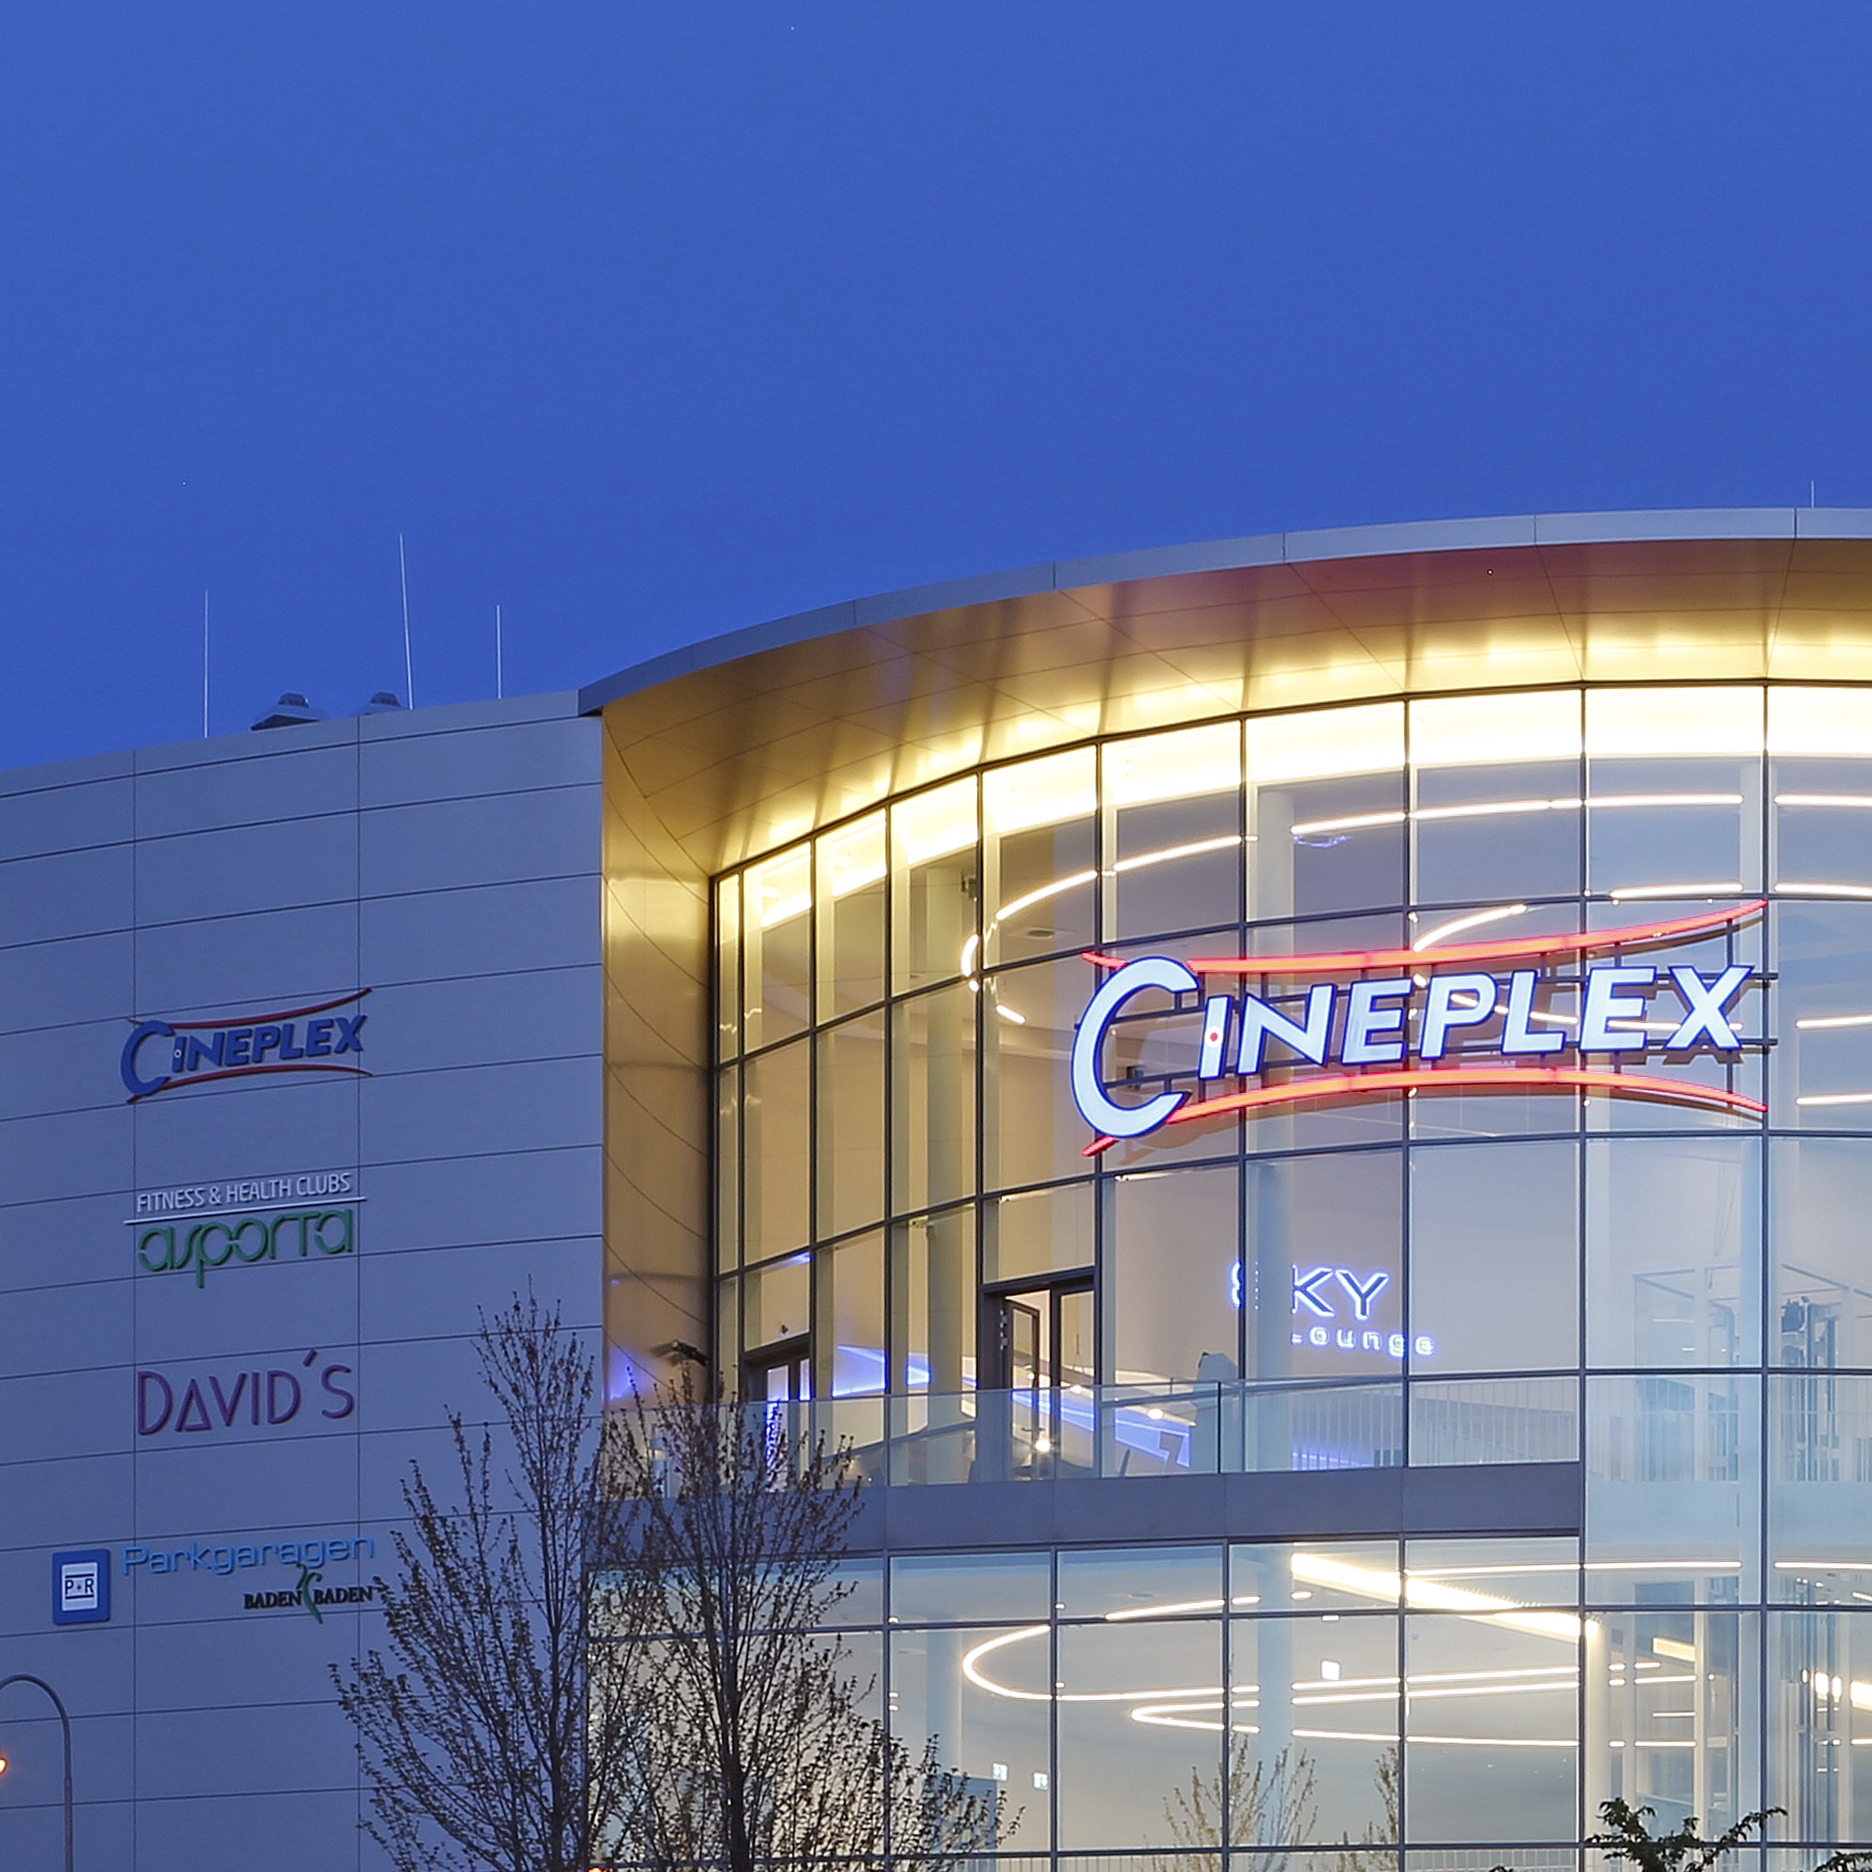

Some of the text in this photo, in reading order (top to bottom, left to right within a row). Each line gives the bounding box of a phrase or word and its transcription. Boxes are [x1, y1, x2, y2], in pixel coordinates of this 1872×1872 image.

[120, 1014, 368, 1097] CINEPLEX
[1070, 955, 1755, 1138] CINEPLEX
[136, 1172, 351, 1213] FITNESS & HEALTH CLUBS
[1291, 1325, 1434, 1359] ounge
[121, 1537, 374, 1576] Parkgaragen
[244, 1585, 373, 1610] BADEN BADEN
